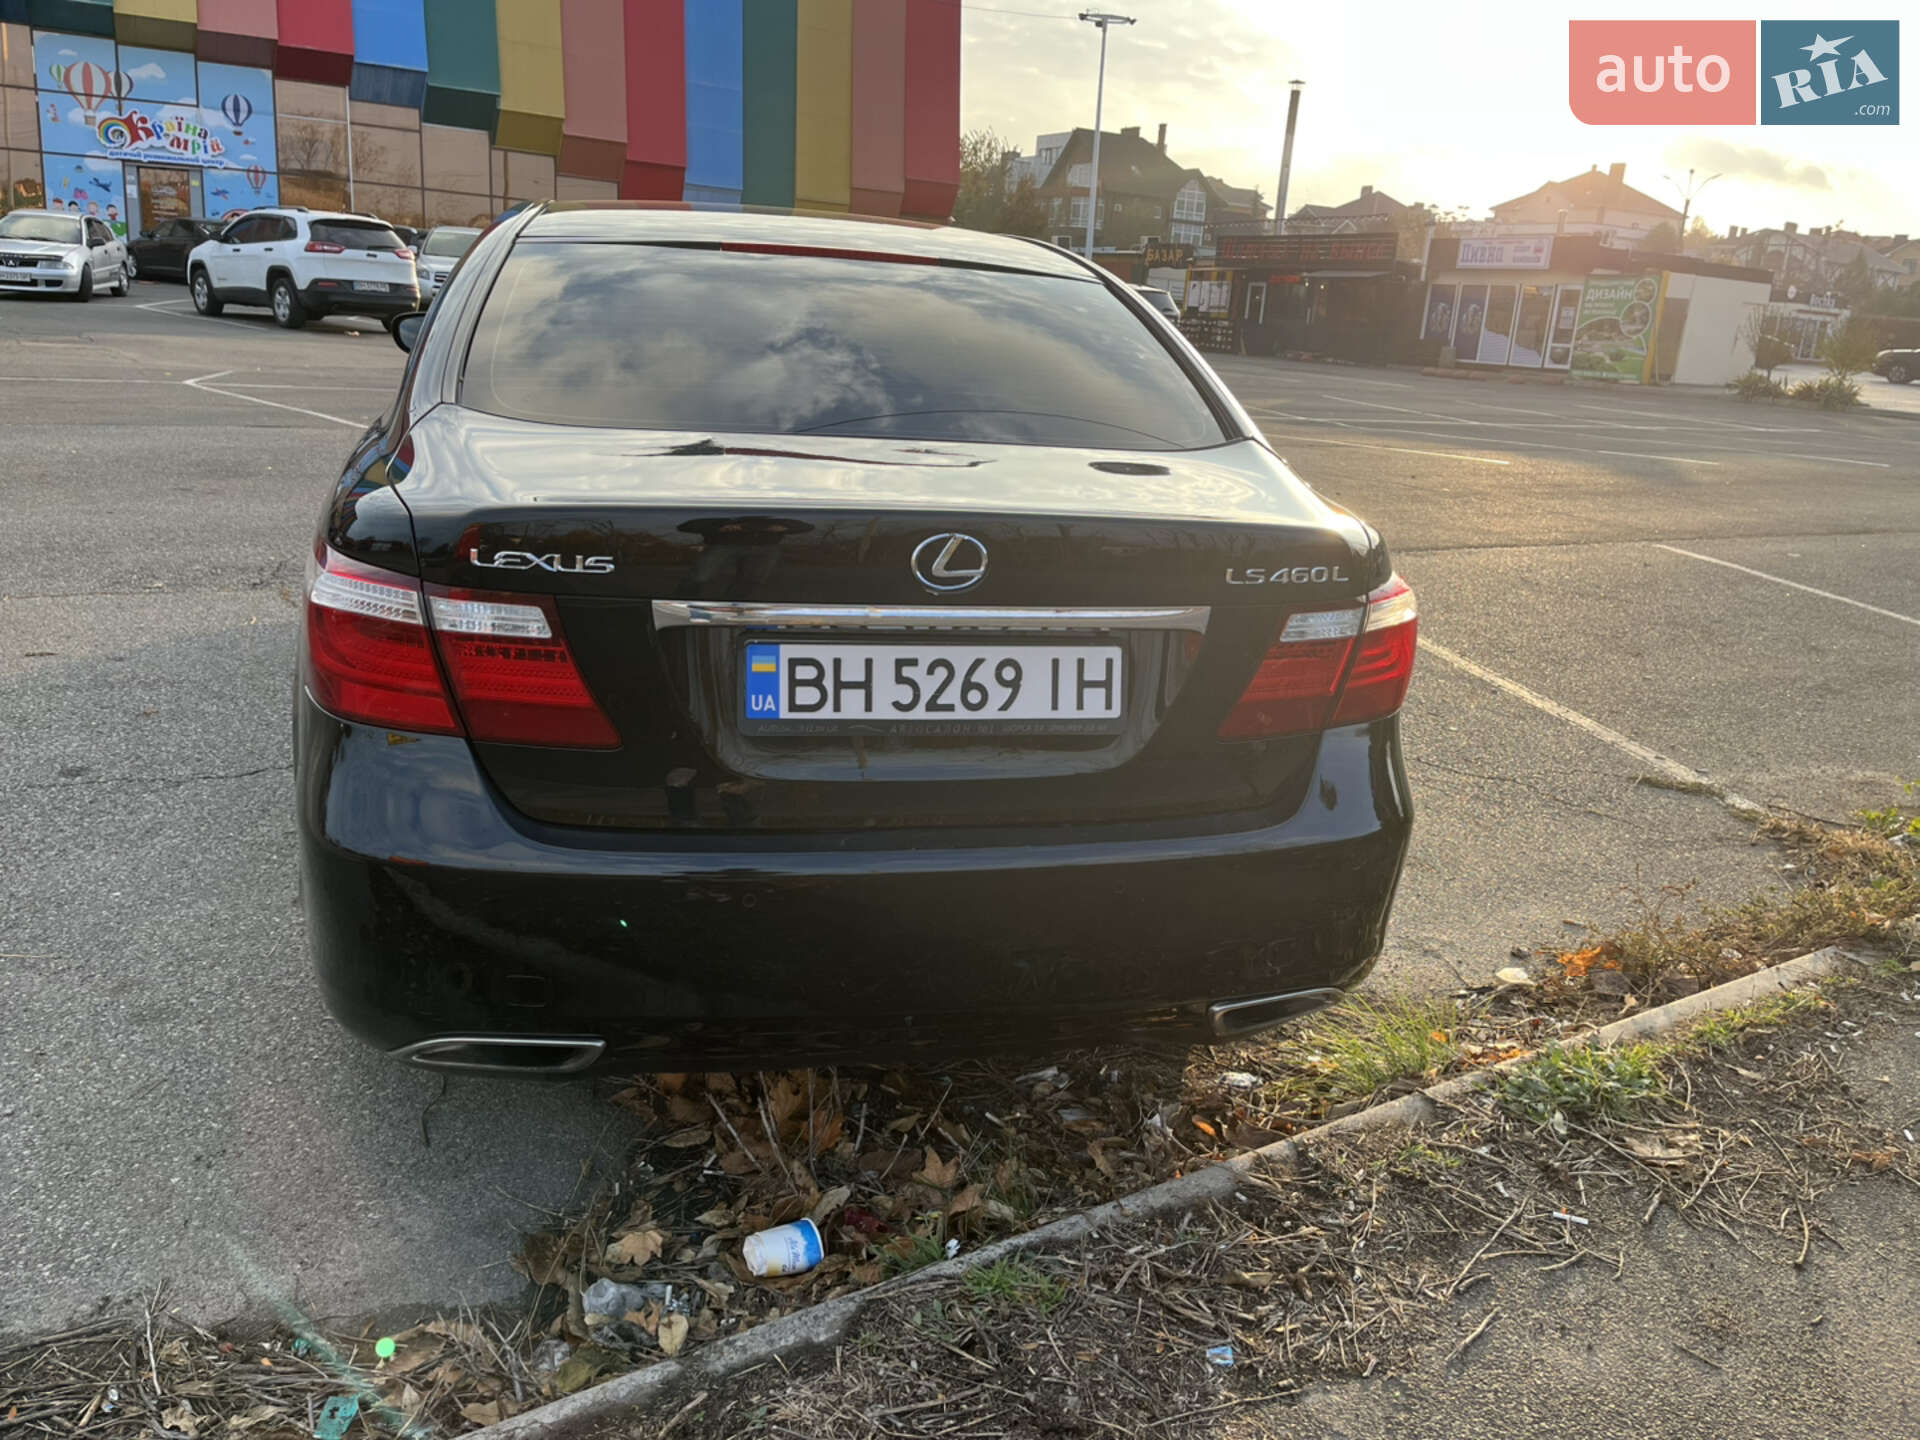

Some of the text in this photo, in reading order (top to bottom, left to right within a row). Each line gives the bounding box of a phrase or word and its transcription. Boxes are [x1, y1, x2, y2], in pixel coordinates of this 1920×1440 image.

[1586, 286, 1633, 301] ДИЗАЙН
[469, 548, 615, 574] LEXUS
[787, 657, 1114, 713] BH 5269 IH
[750, 694, 776, 712] UA
